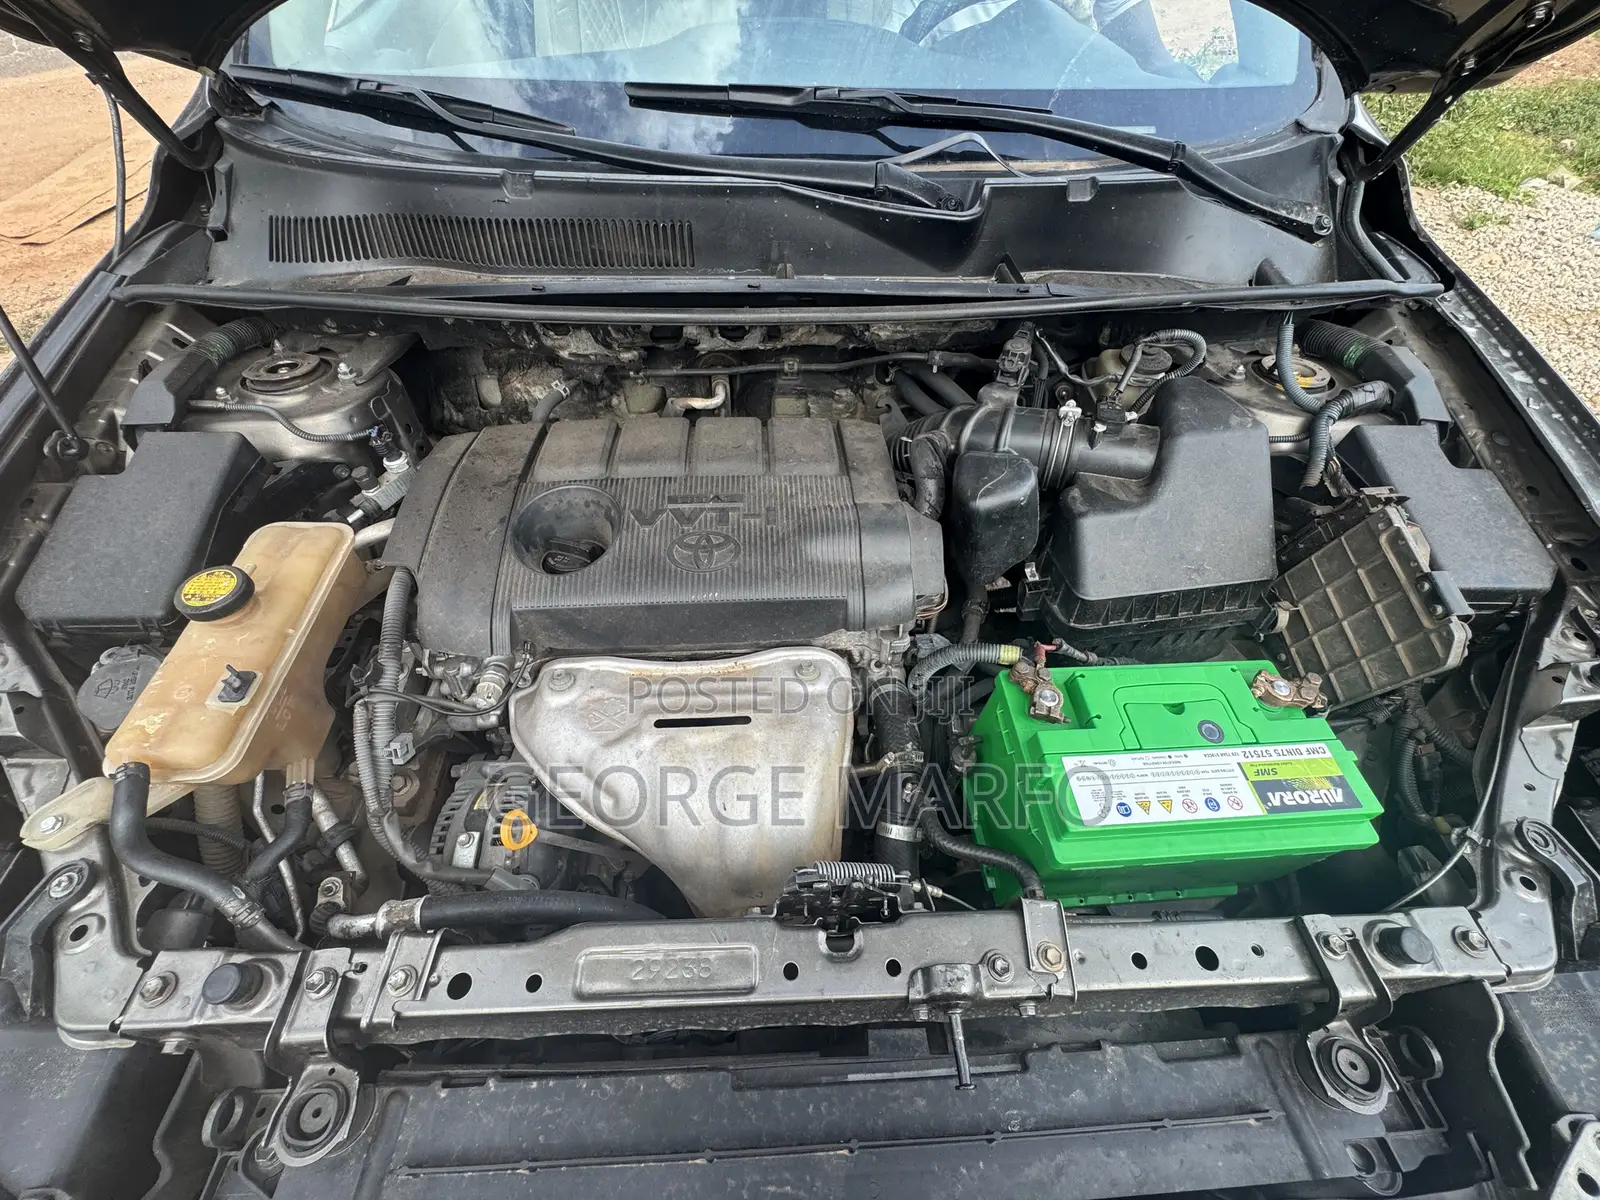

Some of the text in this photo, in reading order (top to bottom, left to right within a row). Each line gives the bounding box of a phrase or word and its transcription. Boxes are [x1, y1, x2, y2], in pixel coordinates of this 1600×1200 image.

[1241, 748, 1272, 759] 57512
[1273, 747, 1303, 758] DIN75
[1305, 746, 1326, 756] CMF
[1254, 767, 1278, 777] SMF
[1267, 788, 1343, 807] AURORA
[631, 957, 713, 981] 29238
